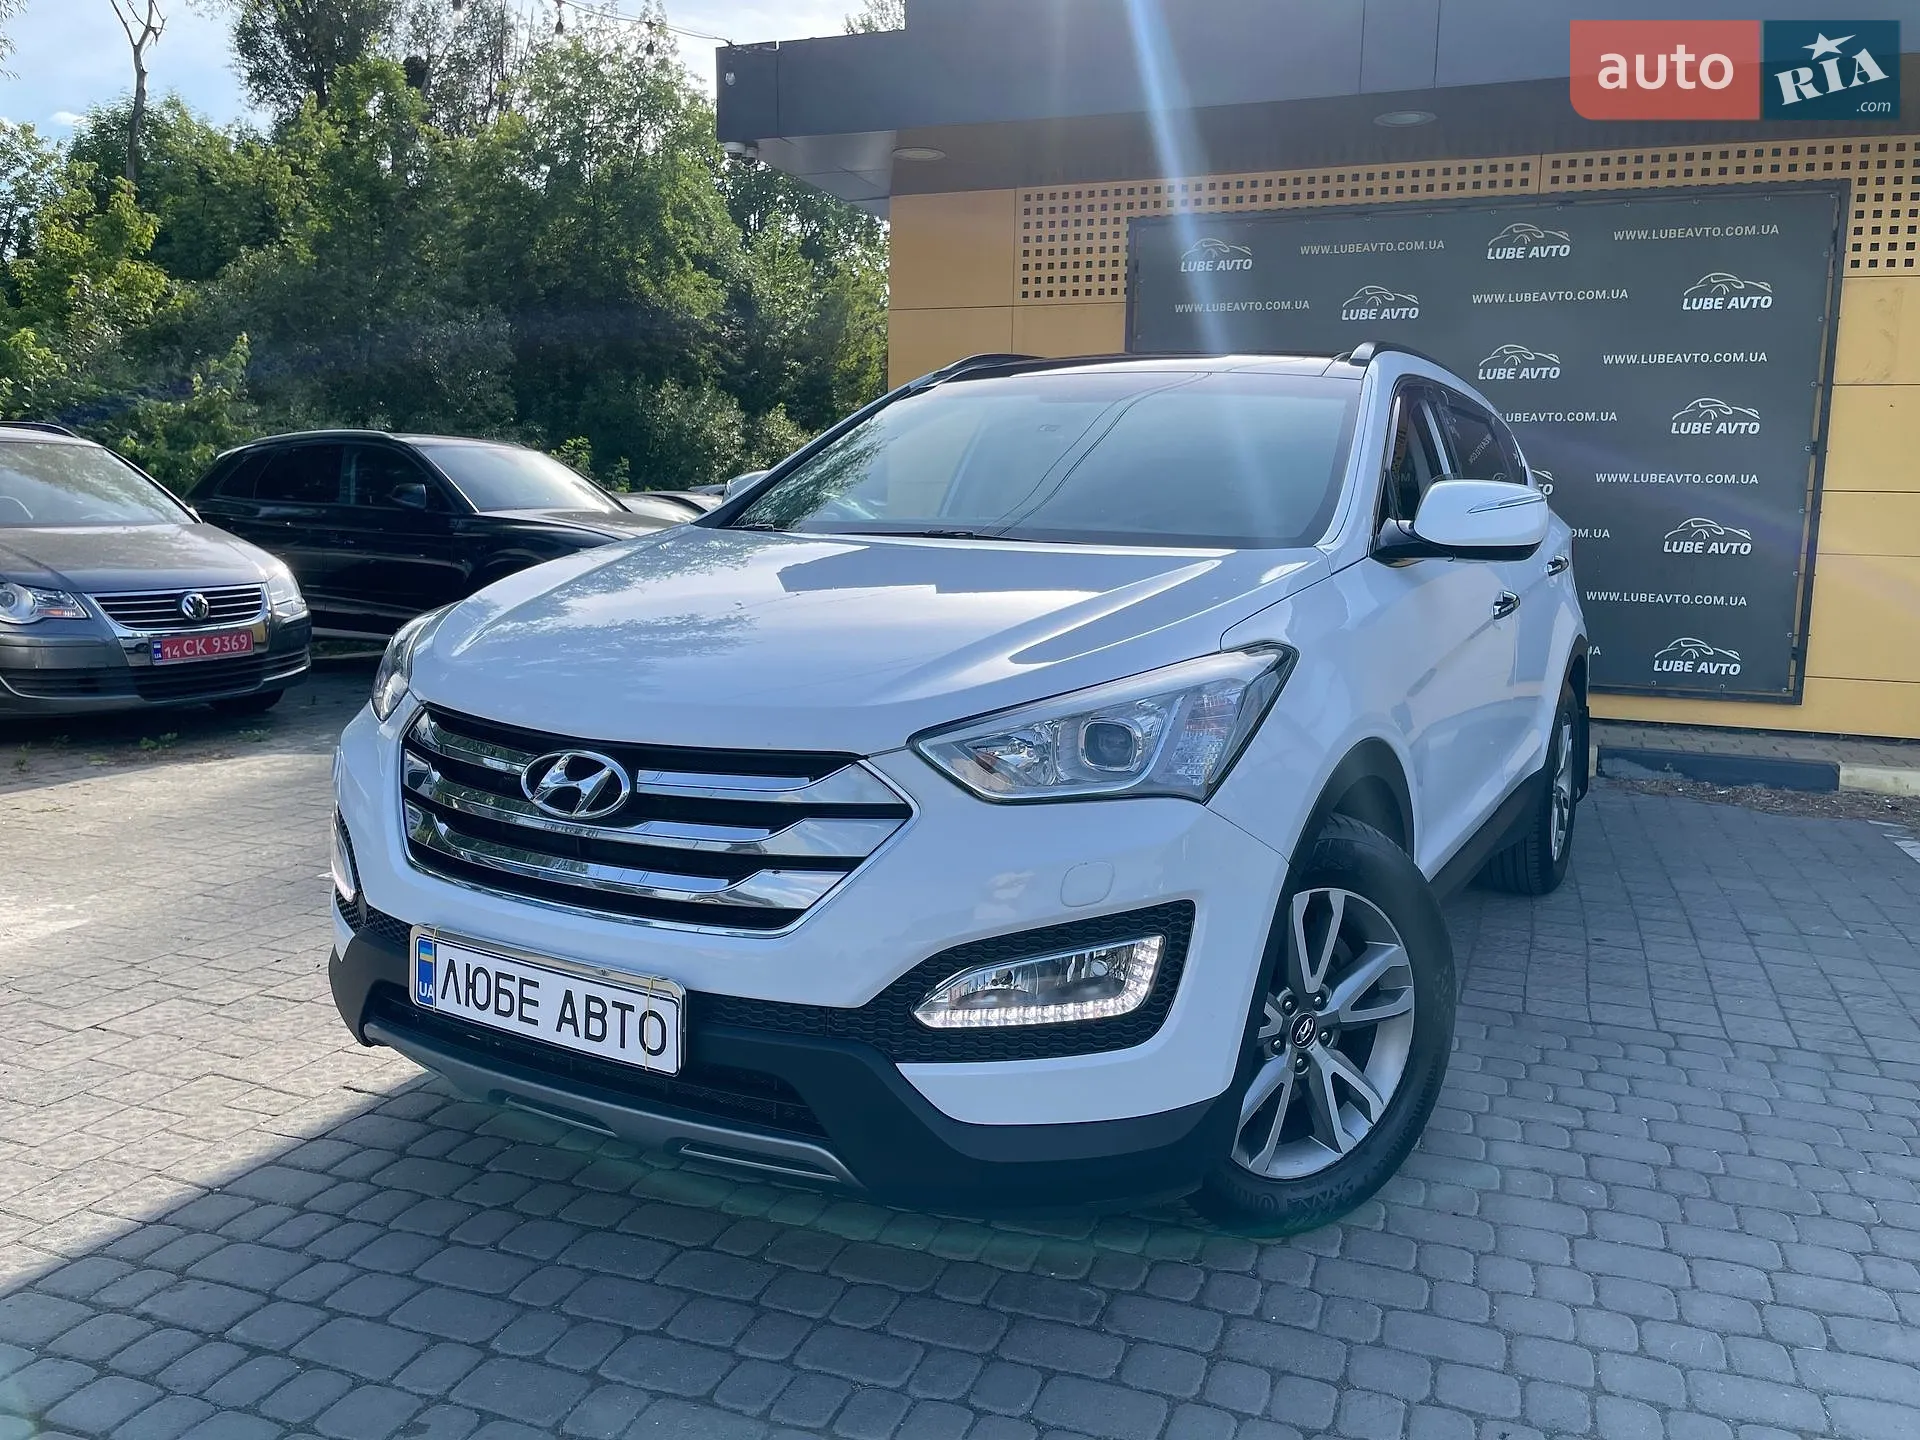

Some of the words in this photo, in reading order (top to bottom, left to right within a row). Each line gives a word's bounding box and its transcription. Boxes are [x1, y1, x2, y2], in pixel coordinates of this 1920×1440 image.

[1613, 224, 1780, 241] WWW.LUBEAVTO.COM.UA
[1300, 240, 1445, 255] WWW.LUBEAVTO.COM.UA
[1487, 246, 1525, 260] LUBE
[1528, 244, 1571, 258] AVTO
[1181, 260, 1214, 272] LUBE
[1216, 258, 1253, 272] AVTO
[1472, 288, 1629, 304] WWW.LUBEAVTO.COM.UA
[1682, 296, 1724, 311] LUBE
[1726, 295, 1773, 310] AVTO
[1175, 300, 1310, 313] WWW.LUBEAVTO.COM.UA
[1341, 308, 1377, 321] LUBE
[1380, 306, 1420, 320] AVTO
[1602, 352, 1768, 365] WWW.LUBEAVTO.COM.UA
[1478, 367, 1516, 380] LUBE
[1519, 366, 1561, 380] AVTO
[1500, 411, 1618, 423] UBEAVTO.COM.UA
[1671, 421, 1711, 435] LUBE
[1715, 421, 1760, 435] AVTO
[1595, 472, 1759, 486] WWW.LUBEAVTO.COM.UA
[1663, 541, 1704, 554] LUBE
[1707, 541, 1752, 556] AVTO
[1586, 590, 1748, 607] WWW.LUBEAVTO.COM.UA
[164, 645, 180, 659] 14
[212, 634, 248, 653] 9369
[1653, 659, 1694, 674] LUBE
[1697, 660, 1741, 676] AVTO
[419, 981, 434, 999] UA
[440, 958, 540, 1027] ЛЮБЕ
[555, 989, 667, 1057] АВТО
